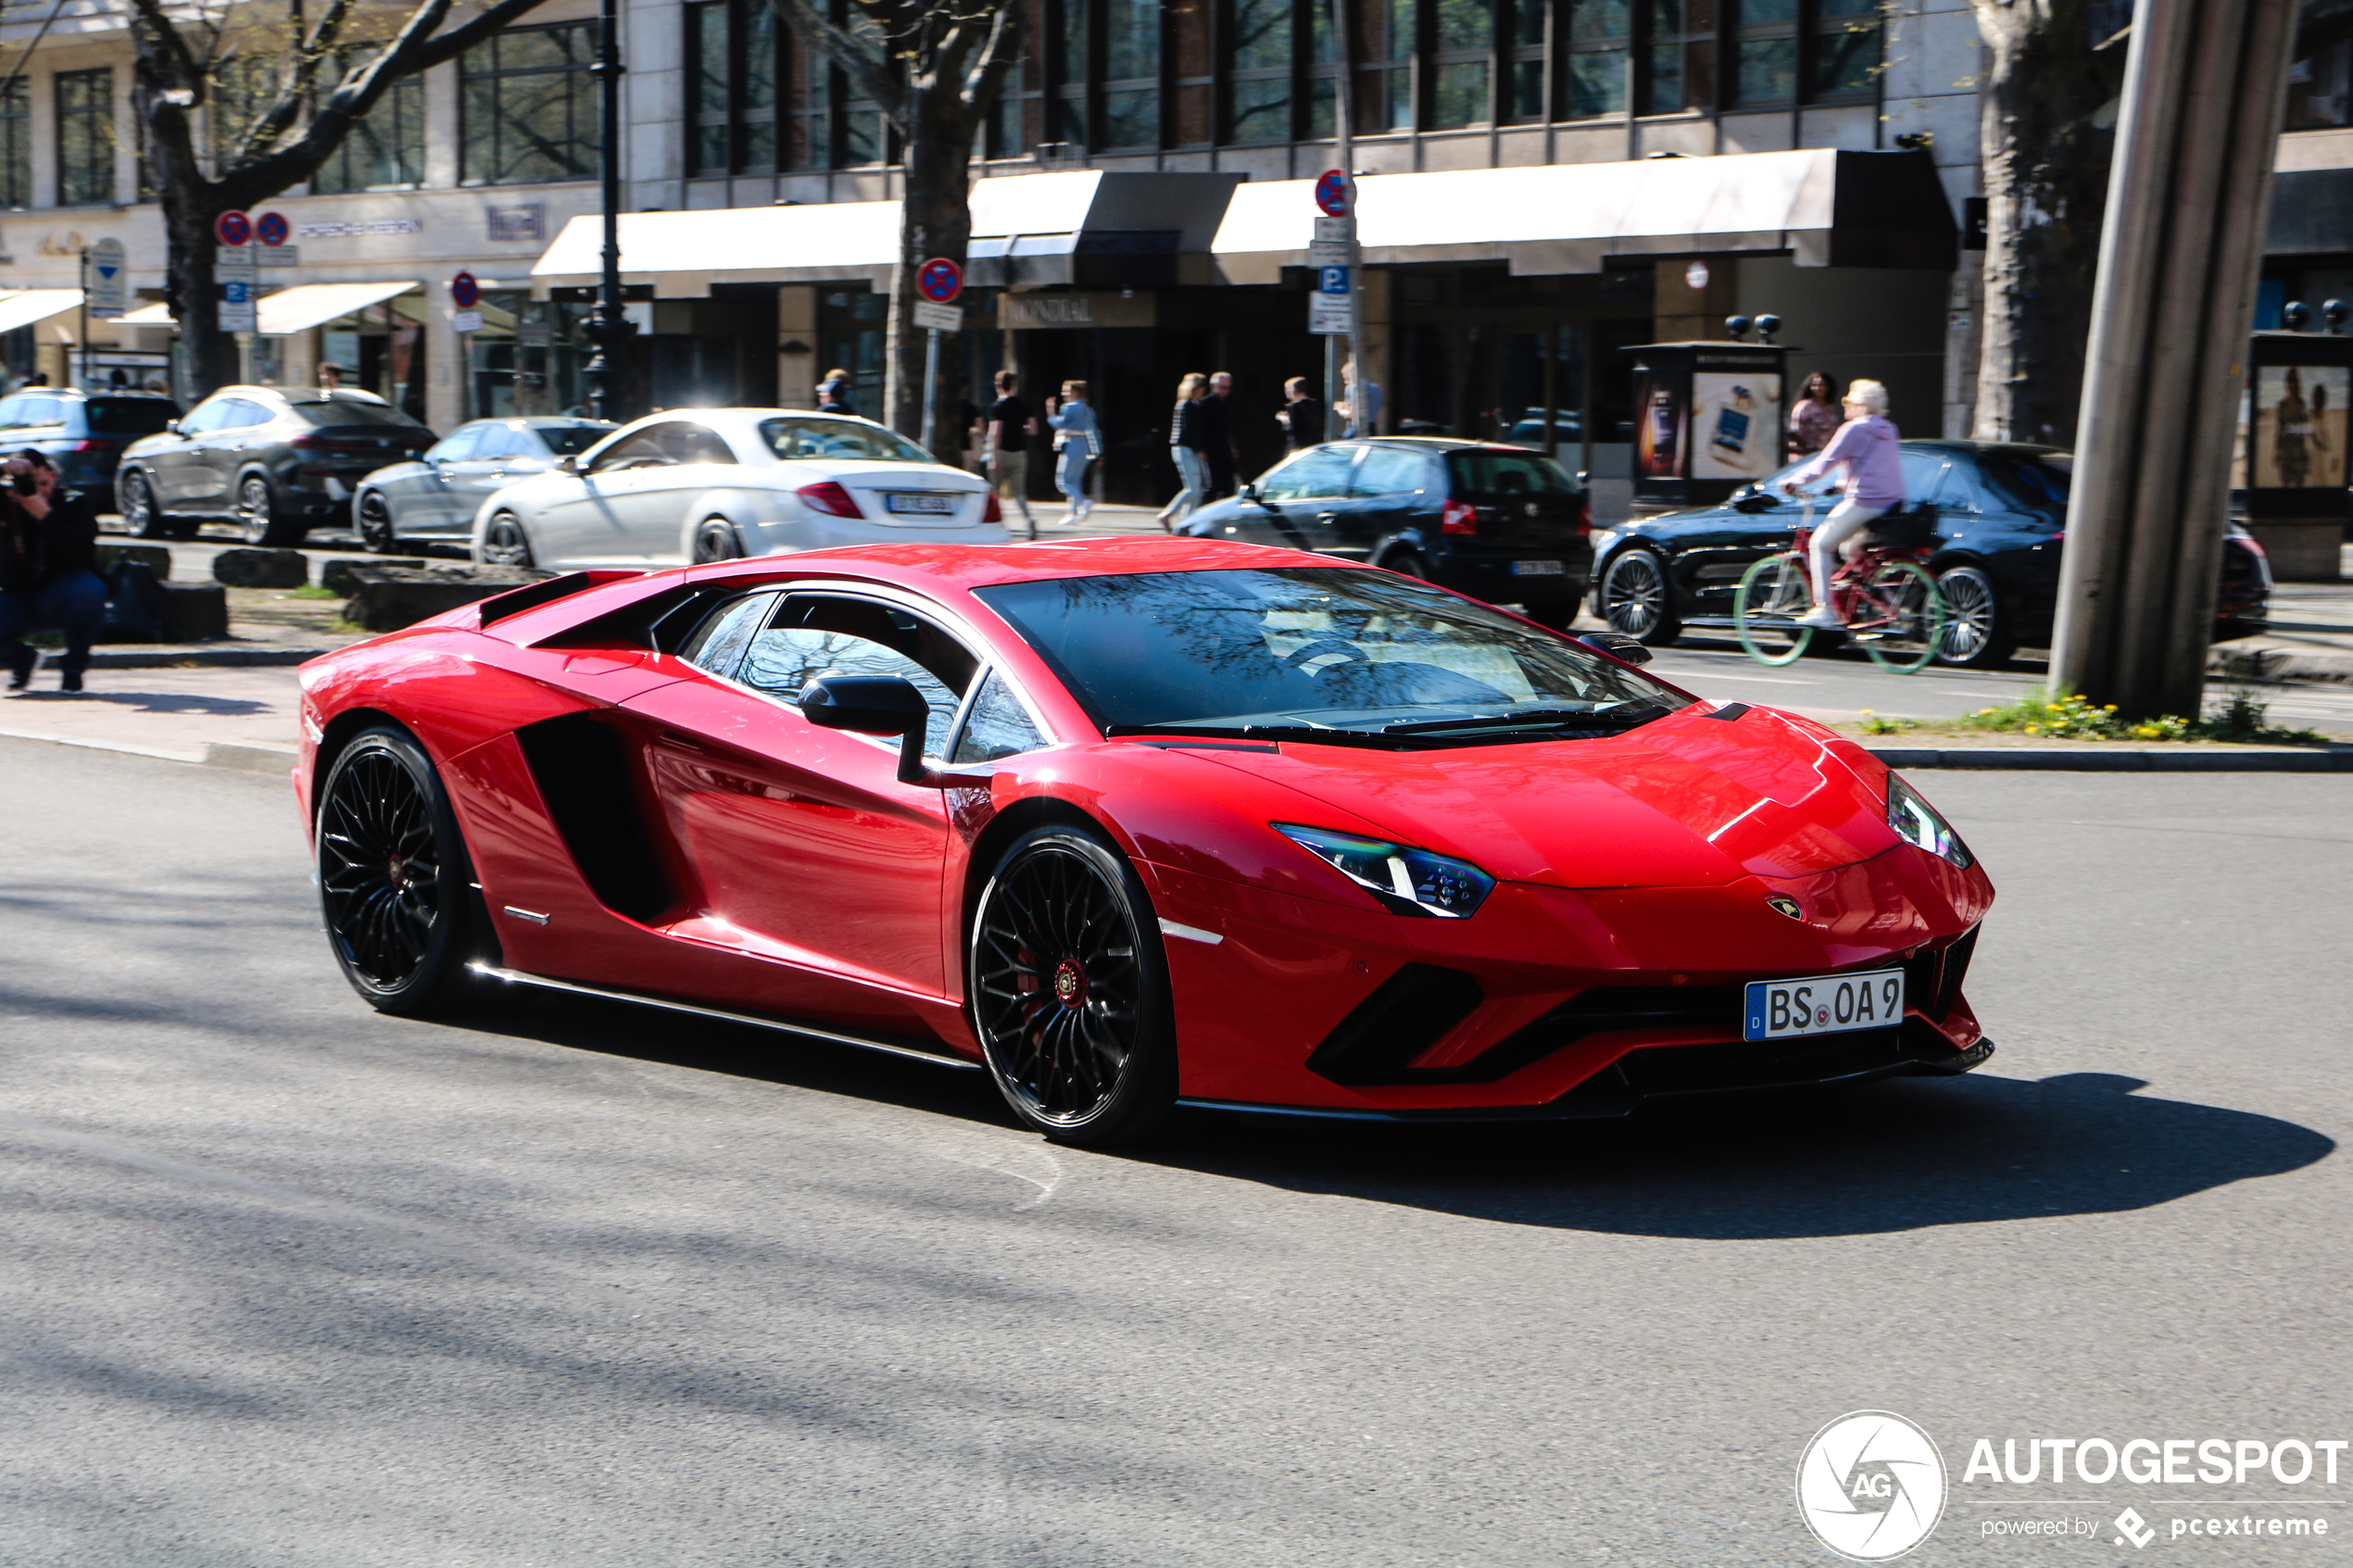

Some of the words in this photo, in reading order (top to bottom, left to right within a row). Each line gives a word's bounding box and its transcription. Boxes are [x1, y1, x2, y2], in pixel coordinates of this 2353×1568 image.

[1770, 986, 1812, 1031] BS
[1834, 980, 1874, 1024] OA
[1882, 977, 1899, 1019] 9
[1752, 1017, 1760, 1029] D
